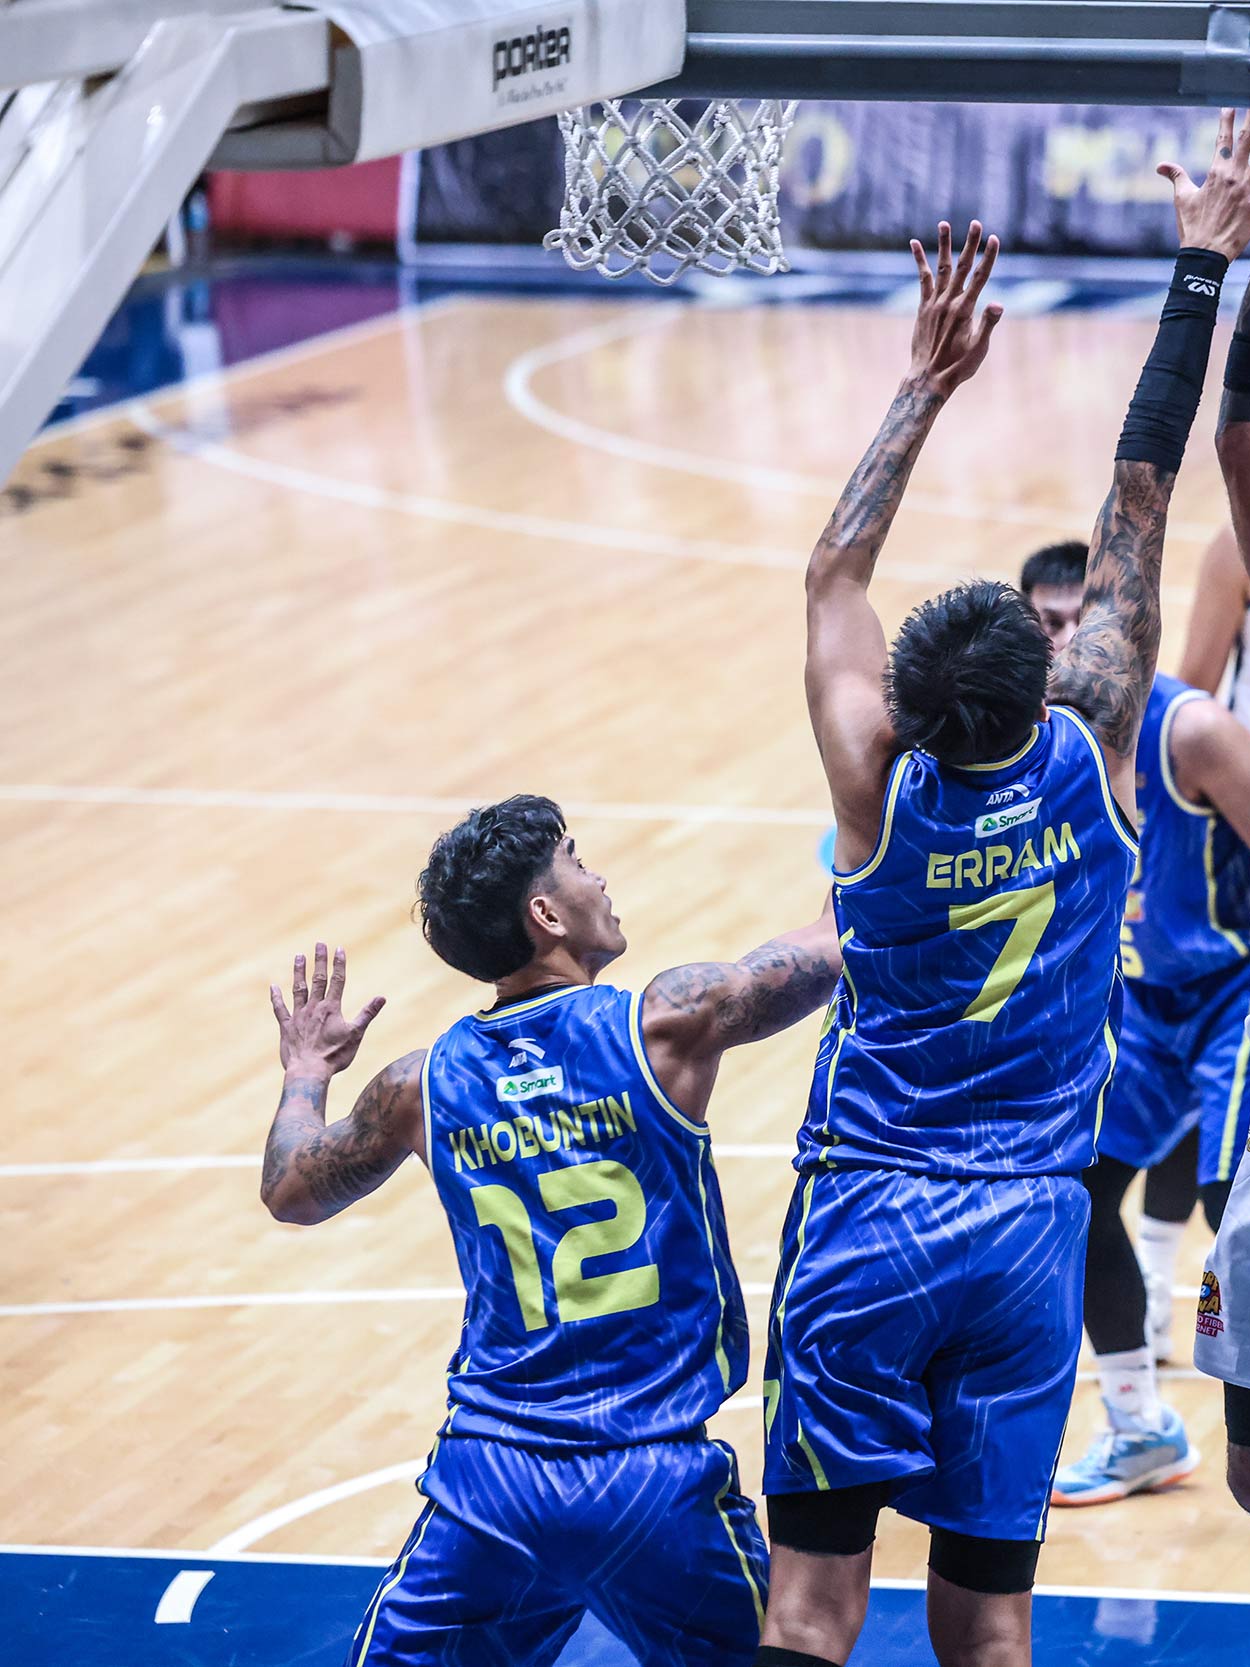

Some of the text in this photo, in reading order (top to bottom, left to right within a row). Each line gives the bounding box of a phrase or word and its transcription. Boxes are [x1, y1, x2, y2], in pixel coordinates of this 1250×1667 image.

[985, 790, 1014, 806] ANTA
[999, 806, 1034, 828] Smart
[926, 822, 1081, 888] ERRAM
[949, 880, 1056, 1022] 7
[520, 1075, 556, 1093] Smart
[449, 1091, 637, 1173] KHOBUNTIN
[470, 1159, 659, 1332] 12
